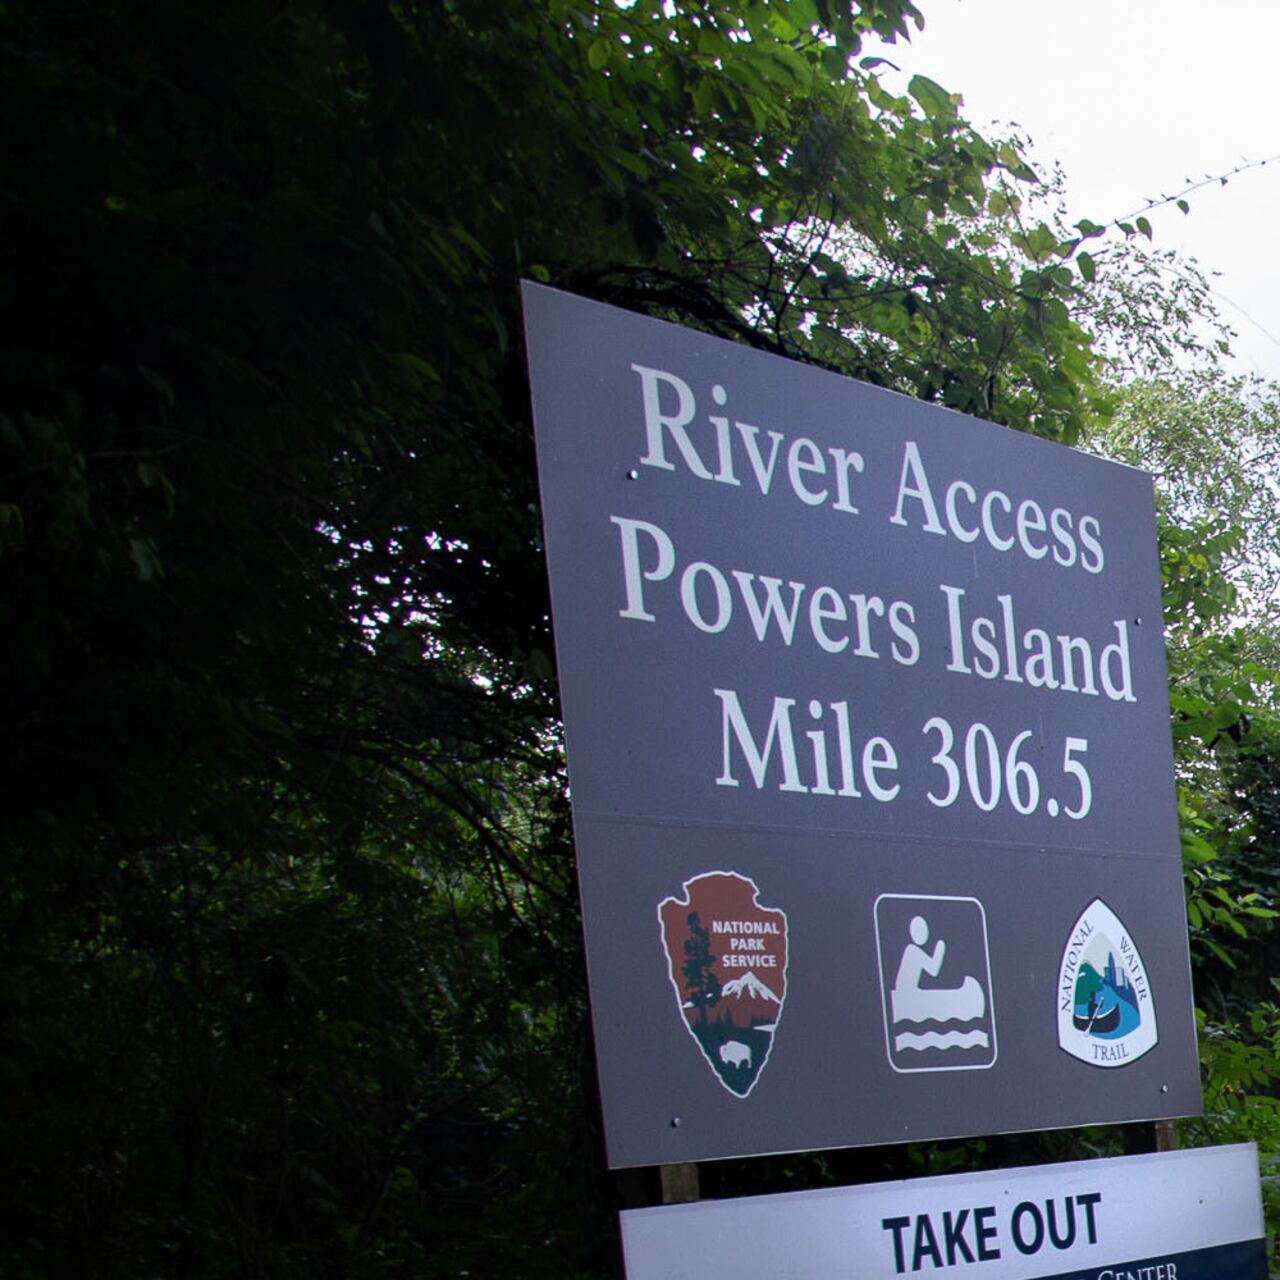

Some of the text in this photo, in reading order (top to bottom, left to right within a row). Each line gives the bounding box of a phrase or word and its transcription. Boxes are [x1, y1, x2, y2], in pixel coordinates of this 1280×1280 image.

[630, 363, 1105, 574] River Access
[609, 515, 1137, 702] Powers Island
[713, 688, 1092, 820] Mile 306.5
[712, 920, 780, 934] NATIONAL
[722, 954, 777, 968] SERVICE
[730, 938, 766, 951] PARK
[1061, 919, 1095, 1013] NATIONAL
[1119, 935, 1148, 1001] WATER
[1091, 1043, 1130, 1061] TRAIL
[882, 1192, 1102, 1274] TAKE OUT
